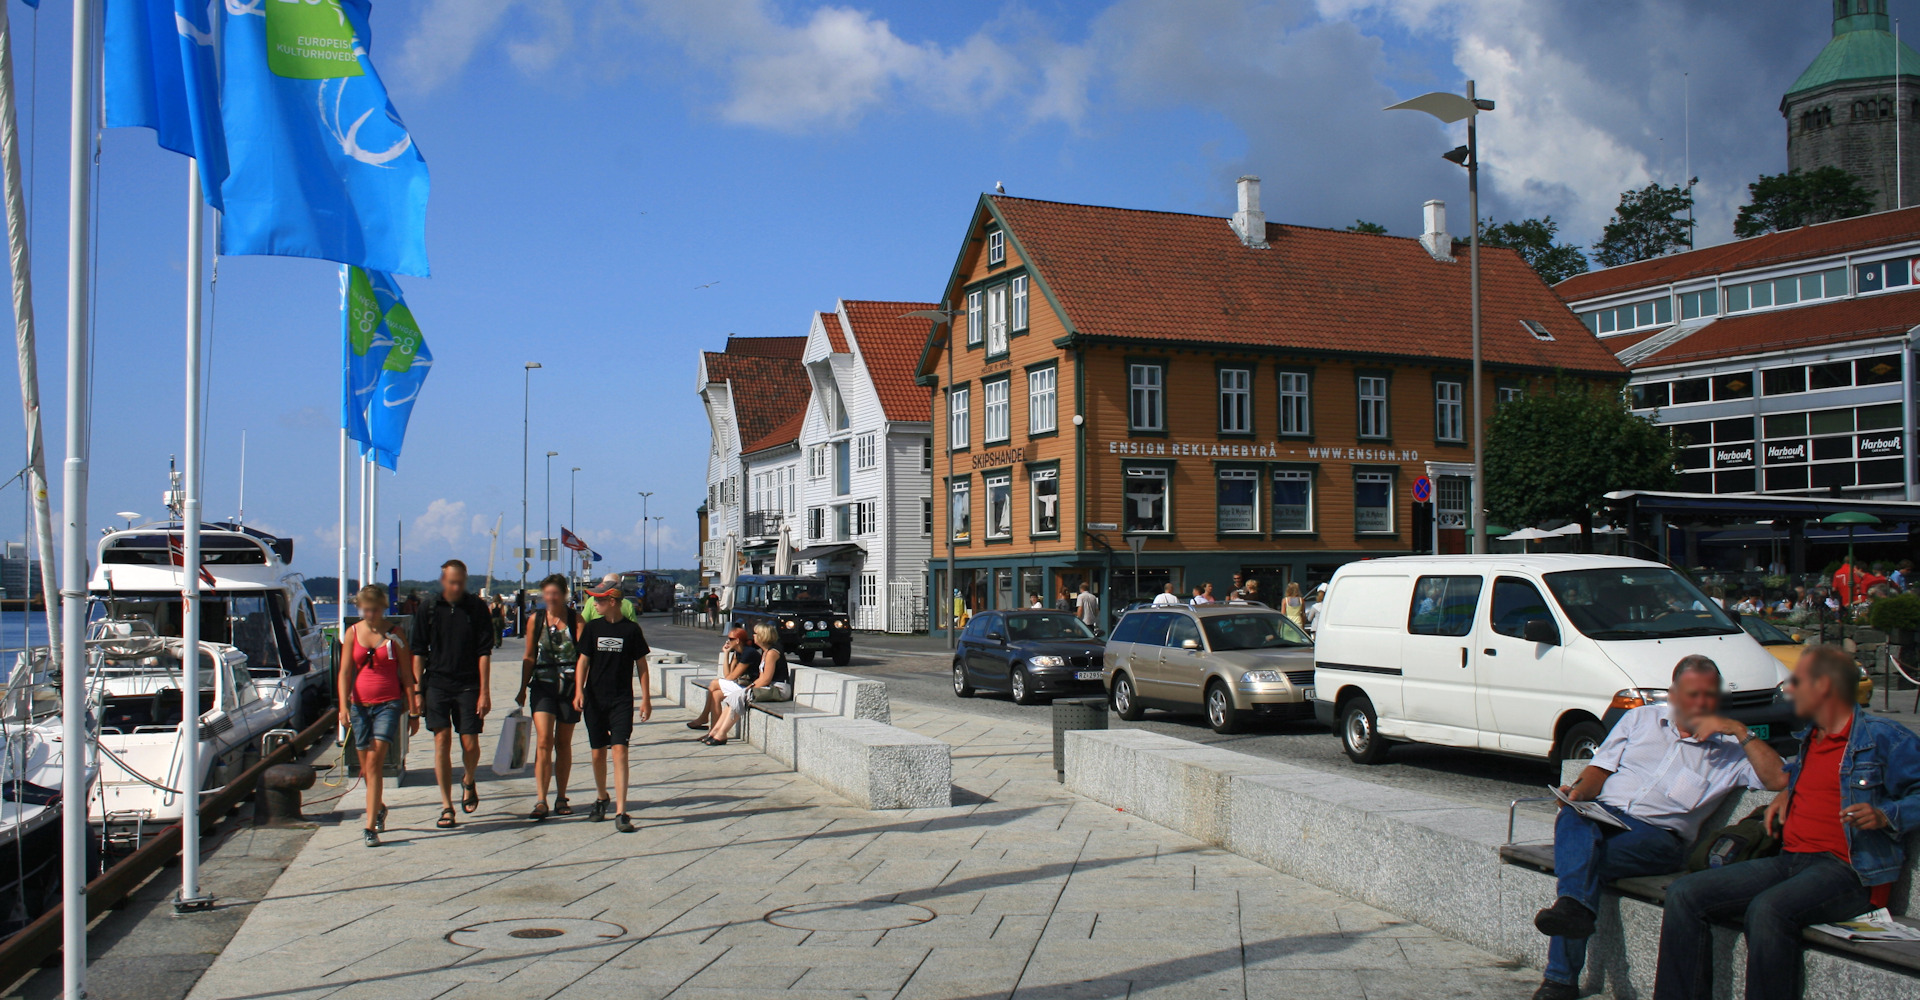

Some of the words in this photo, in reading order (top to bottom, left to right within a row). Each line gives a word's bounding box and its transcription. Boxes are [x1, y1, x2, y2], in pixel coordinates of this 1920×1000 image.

[297, 36, 351, 49] EUROPEIS
[972, 447, 1027, 469] SKIPSHANDEL
[1109, 441, 1165, 455] ENSIGN
[1172, 441, 1277, 457] REKLAMEBYRÅ
[1307, 447, 1419, 461] WWW.ENSIGN.NO
